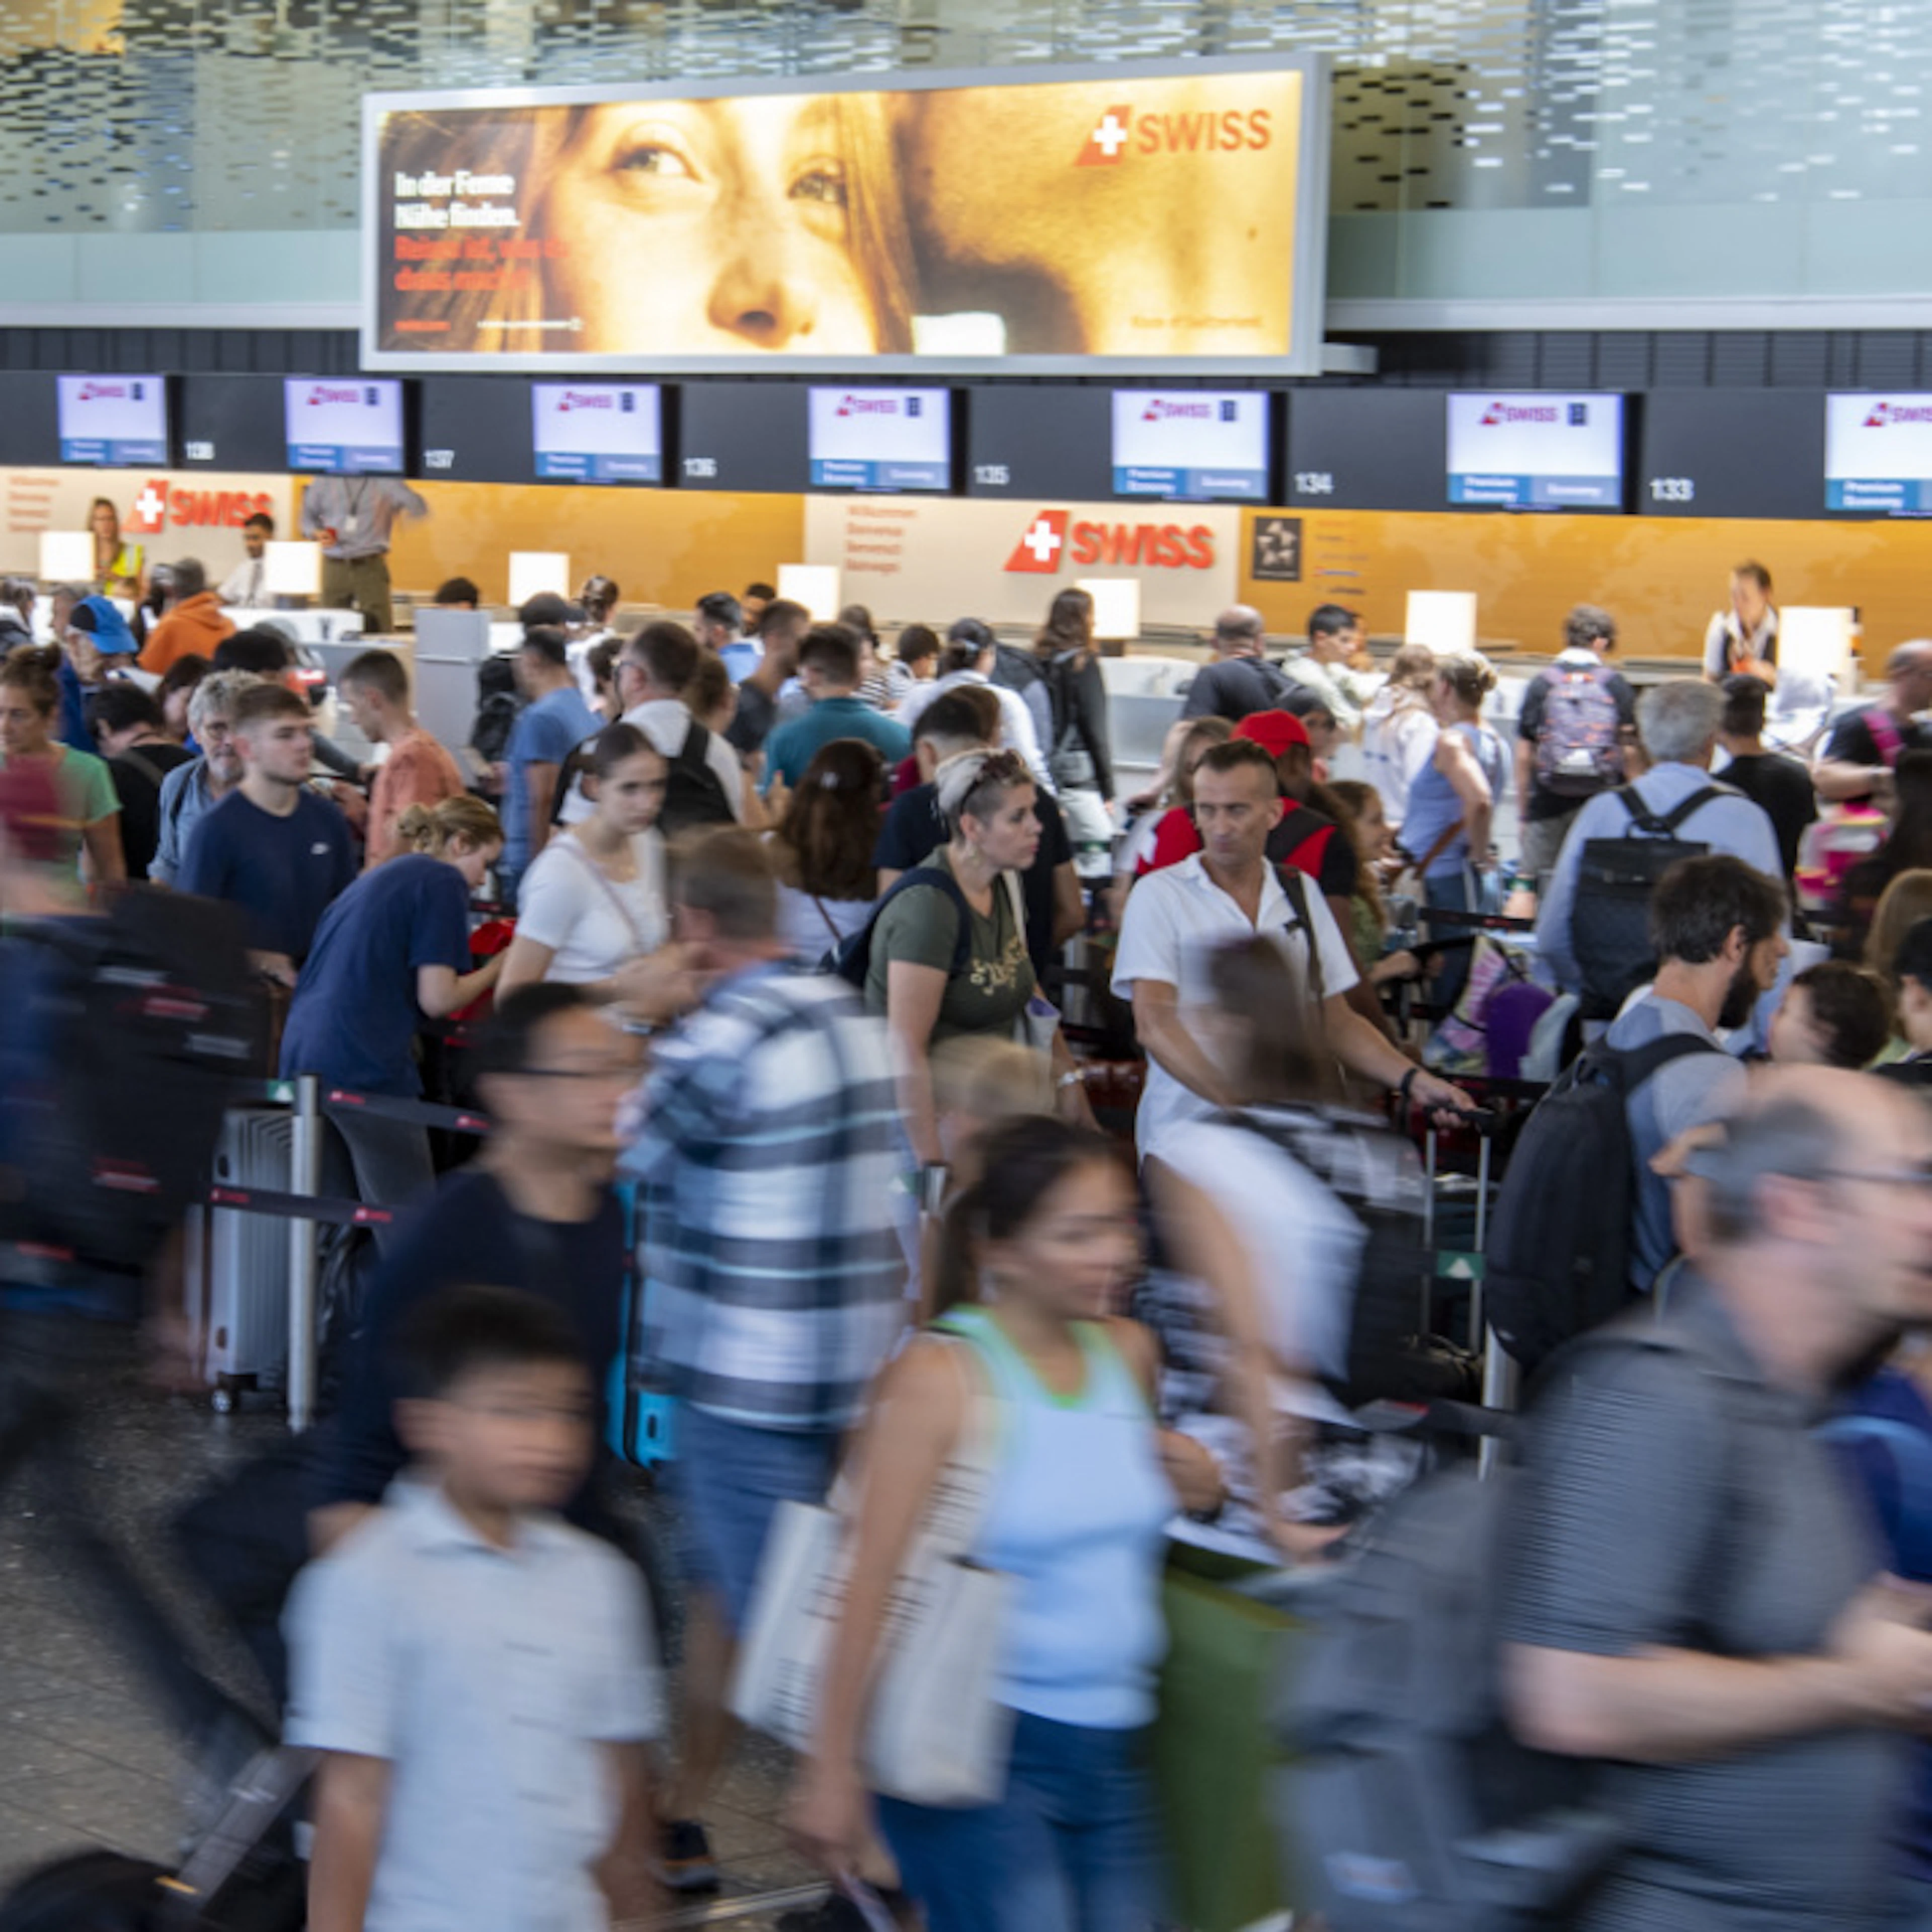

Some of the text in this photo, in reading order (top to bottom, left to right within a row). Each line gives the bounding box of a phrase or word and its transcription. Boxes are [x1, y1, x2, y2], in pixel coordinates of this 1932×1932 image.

[1137, 109, 1270, 154] SWISS
[974, 465, 1010, 485] 135
[1295, 472, 1334, 495] 134
[1650, 478, 1694, 502] 133
[1071, 520, 1216, 569] SWISS
